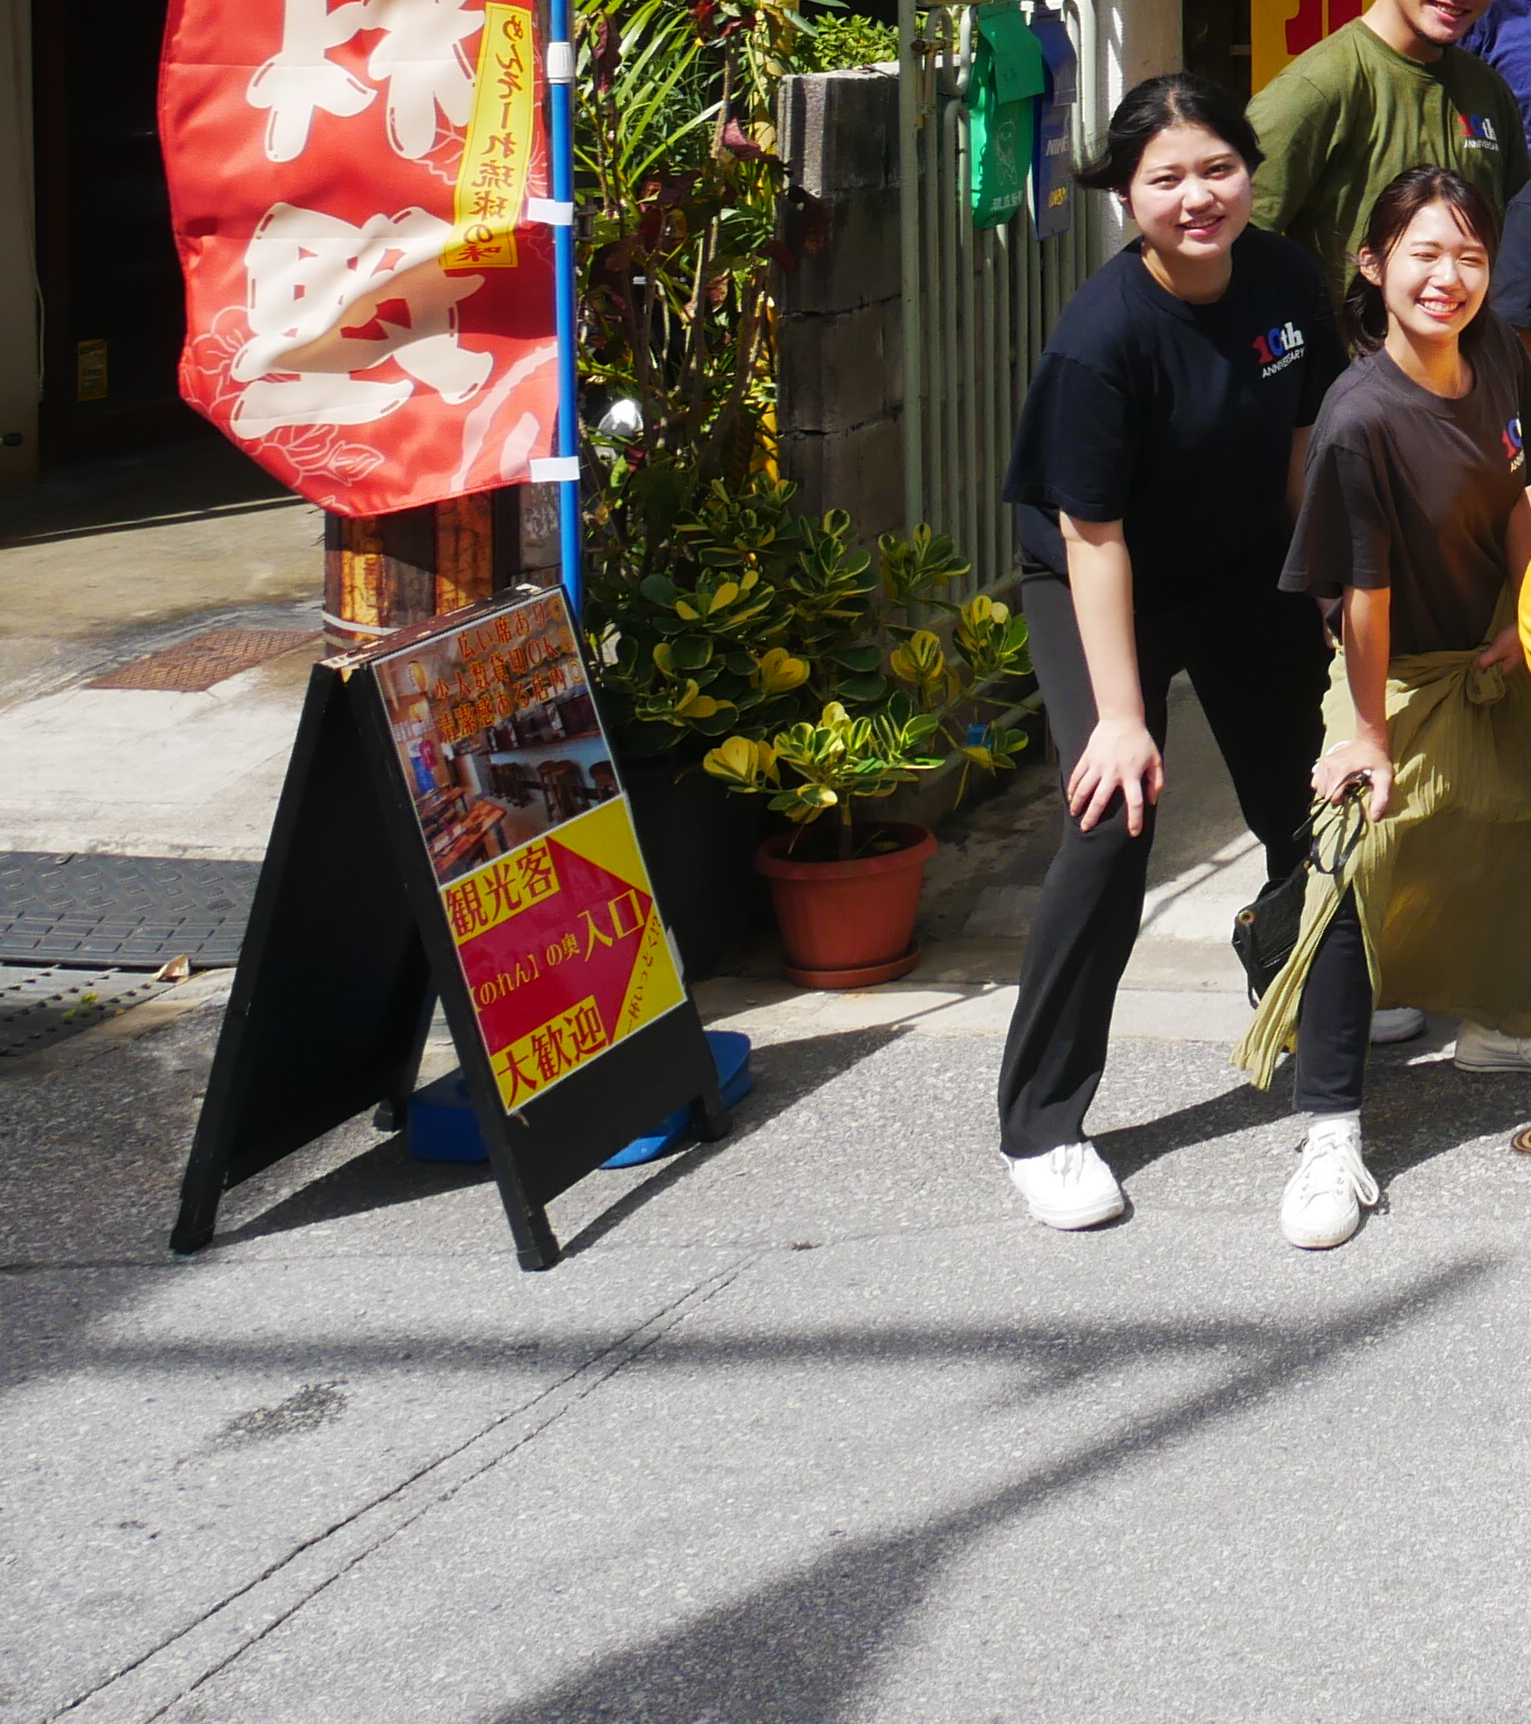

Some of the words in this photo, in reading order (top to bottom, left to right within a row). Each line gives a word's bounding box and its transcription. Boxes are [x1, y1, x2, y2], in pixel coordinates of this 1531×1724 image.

[1252, 321, 1304, 364] 10th
[1262, 347, 1305, 379] ANNIVERSARY
[447, 845, 552, 937] 観光客
[497, 1004, 607, 1107] 大歓迎
